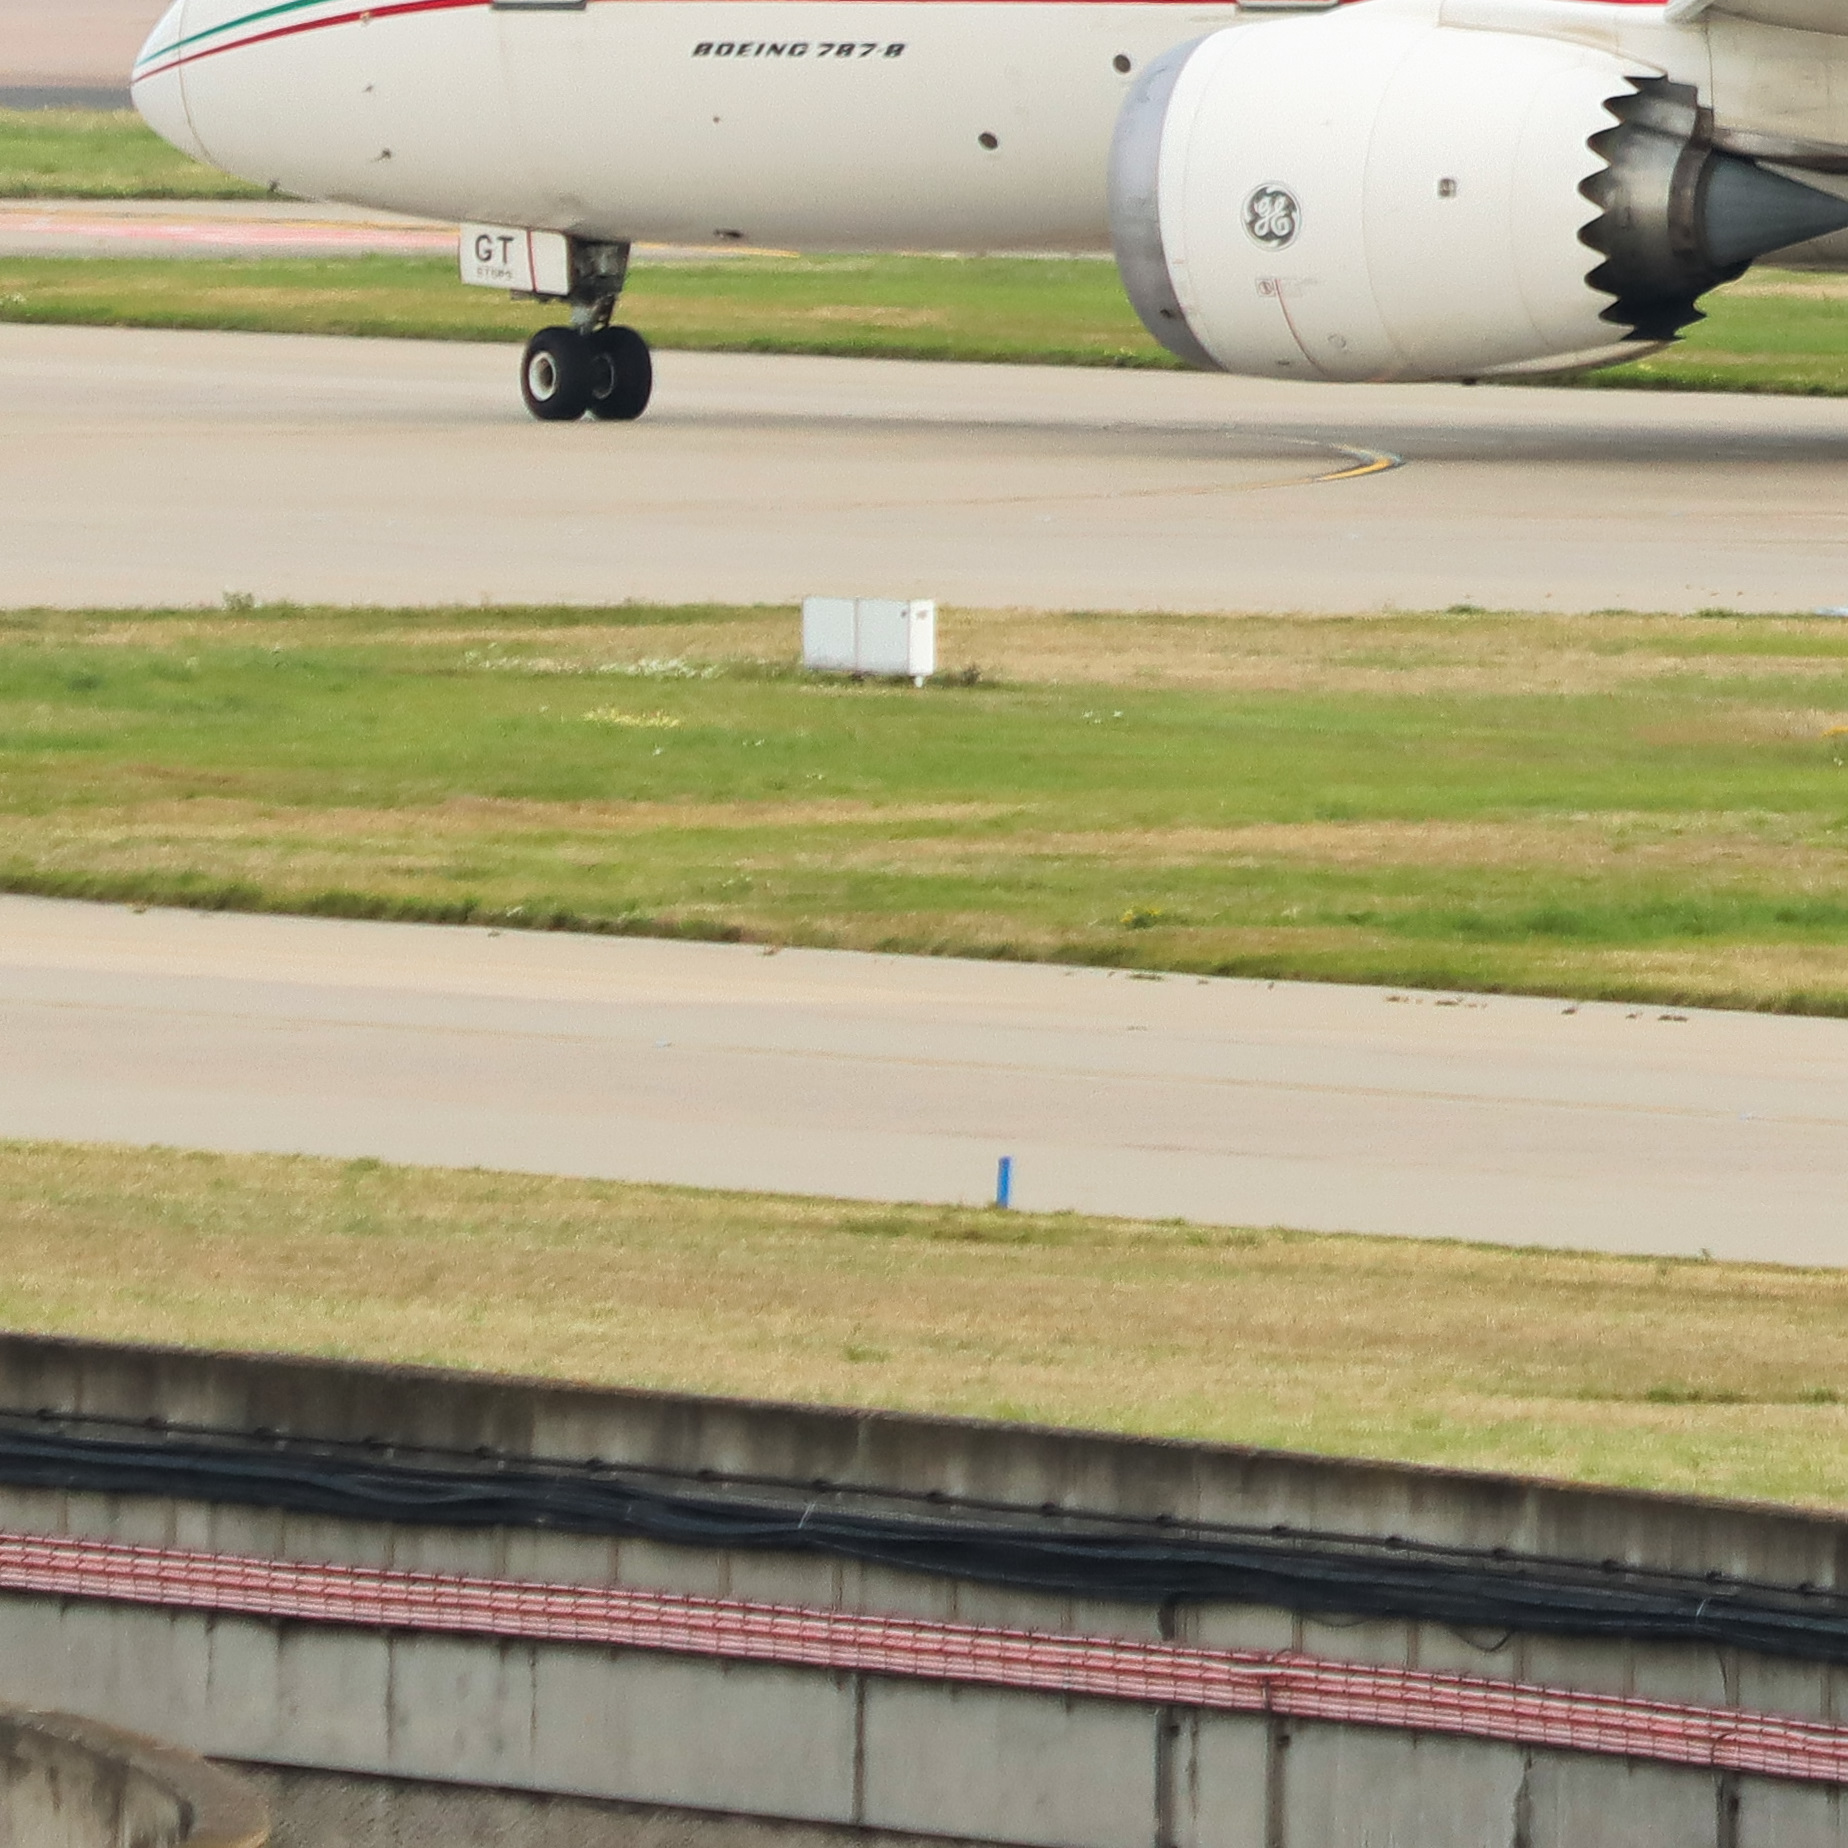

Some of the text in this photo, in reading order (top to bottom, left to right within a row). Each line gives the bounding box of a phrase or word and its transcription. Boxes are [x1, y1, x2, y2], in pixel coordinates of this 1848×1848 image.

[691, 42, 906, 58] BOEING 787-8
[474, 234, 515, 264] GT
